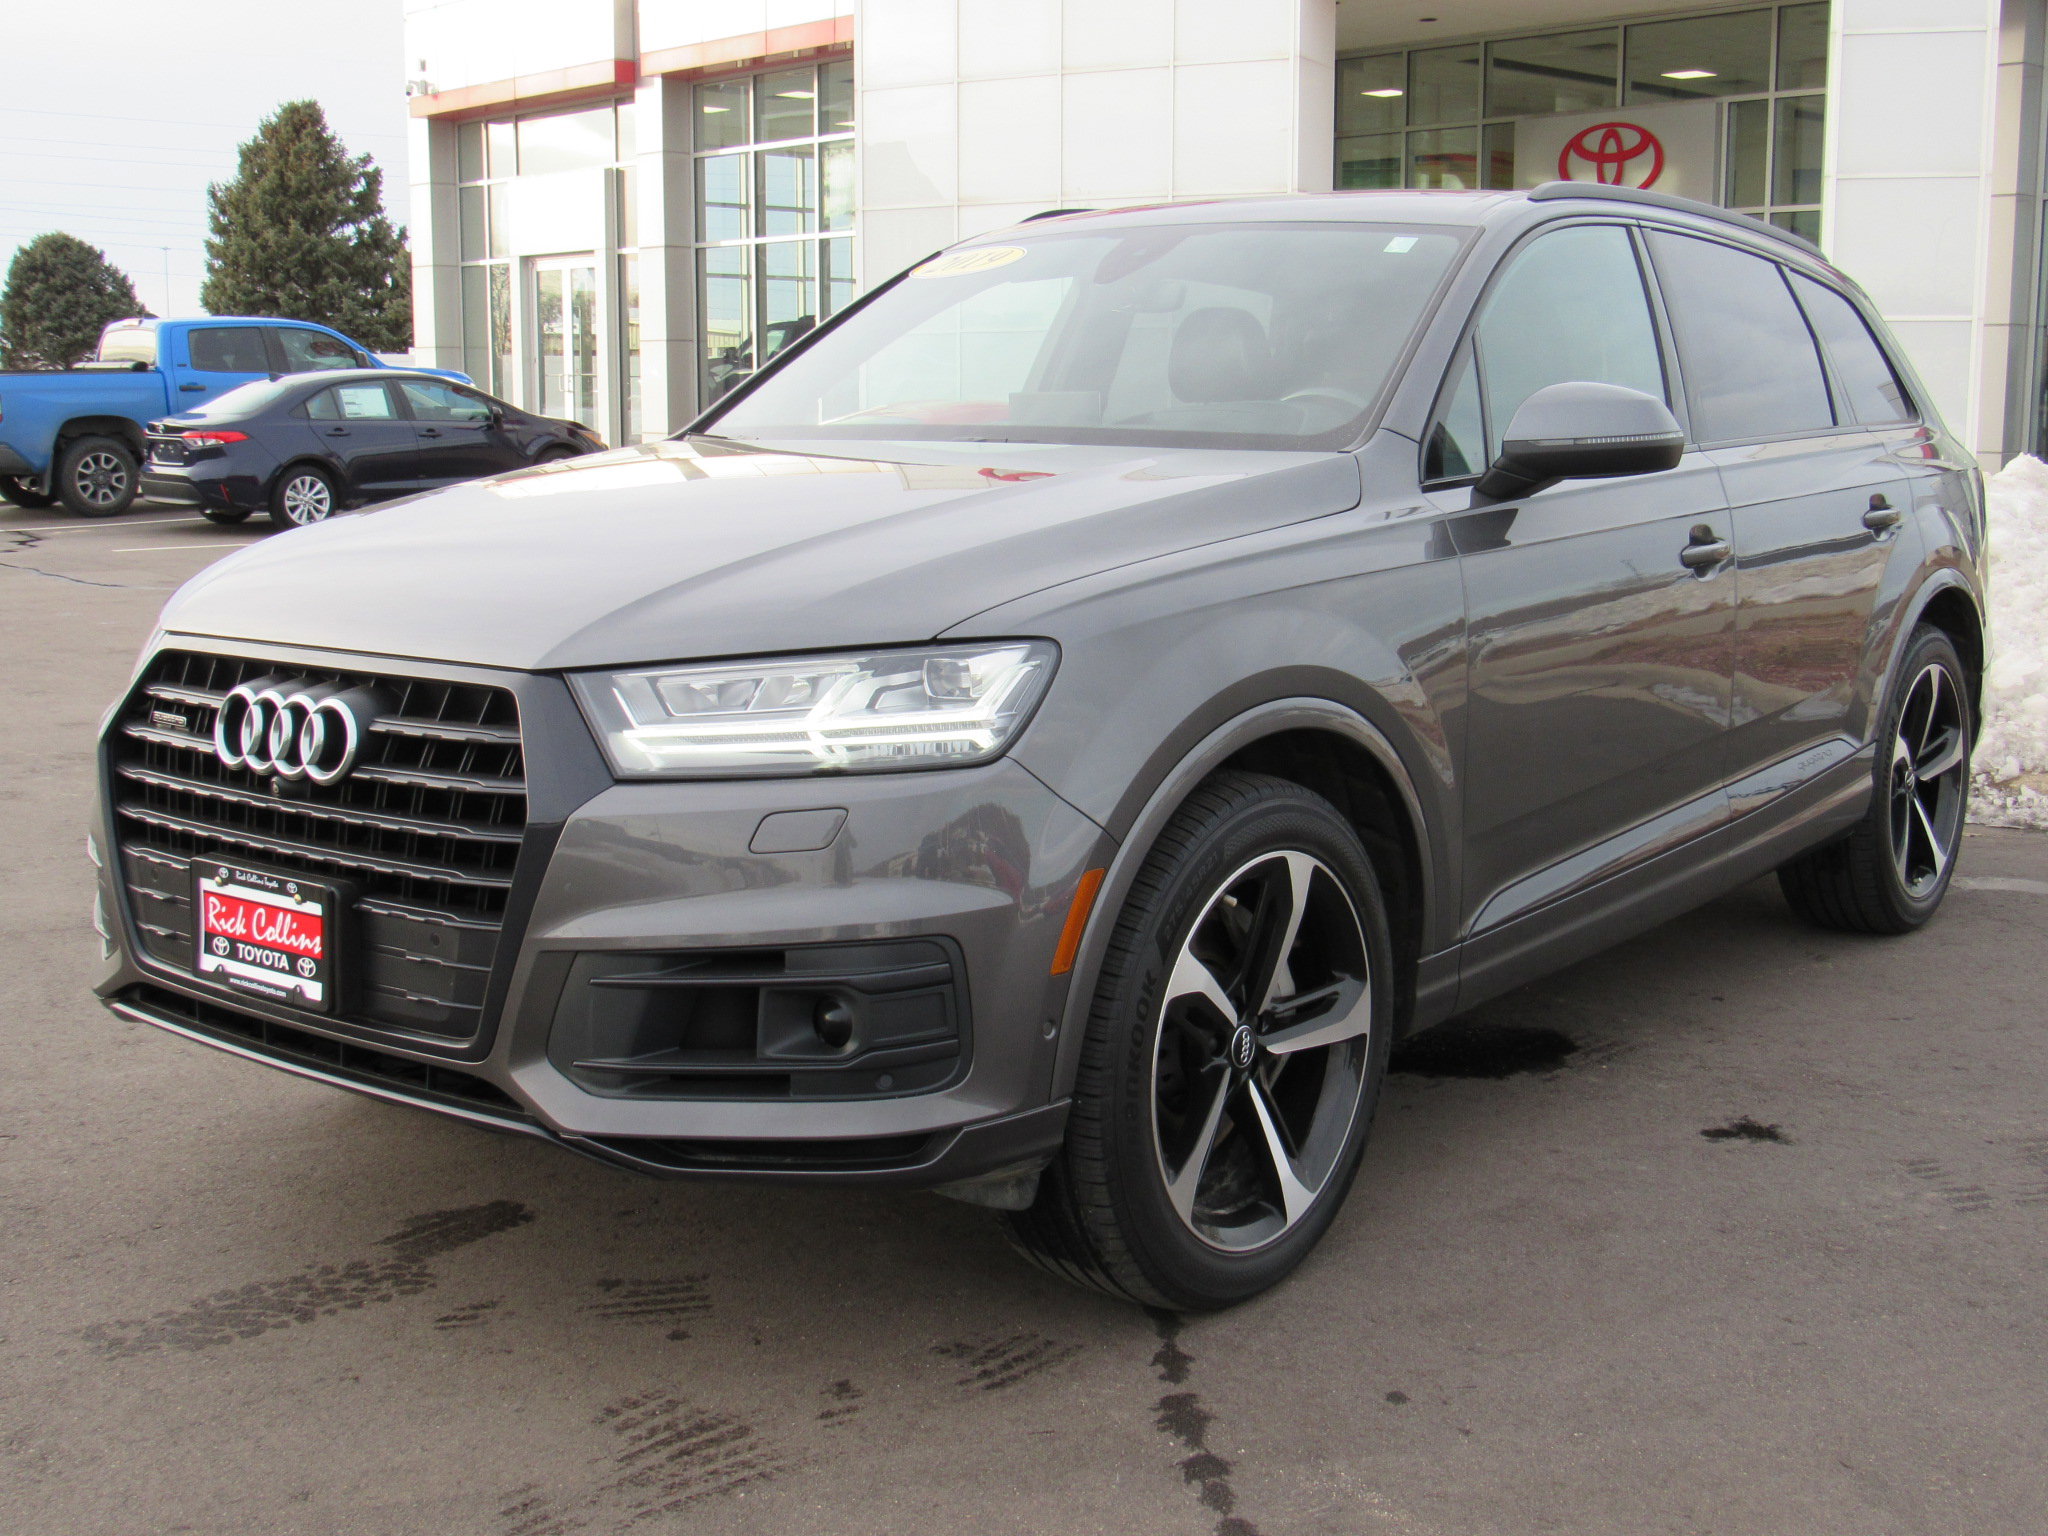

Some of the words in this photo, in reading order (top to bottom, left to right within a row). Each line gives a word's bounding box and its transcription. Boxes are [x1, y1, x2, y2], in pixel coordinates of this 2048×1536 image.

[208, 896, 247, 936] Rick
[252, 907, 322, 954] Collins
[236, 943, 290, 970] TOYOTA
